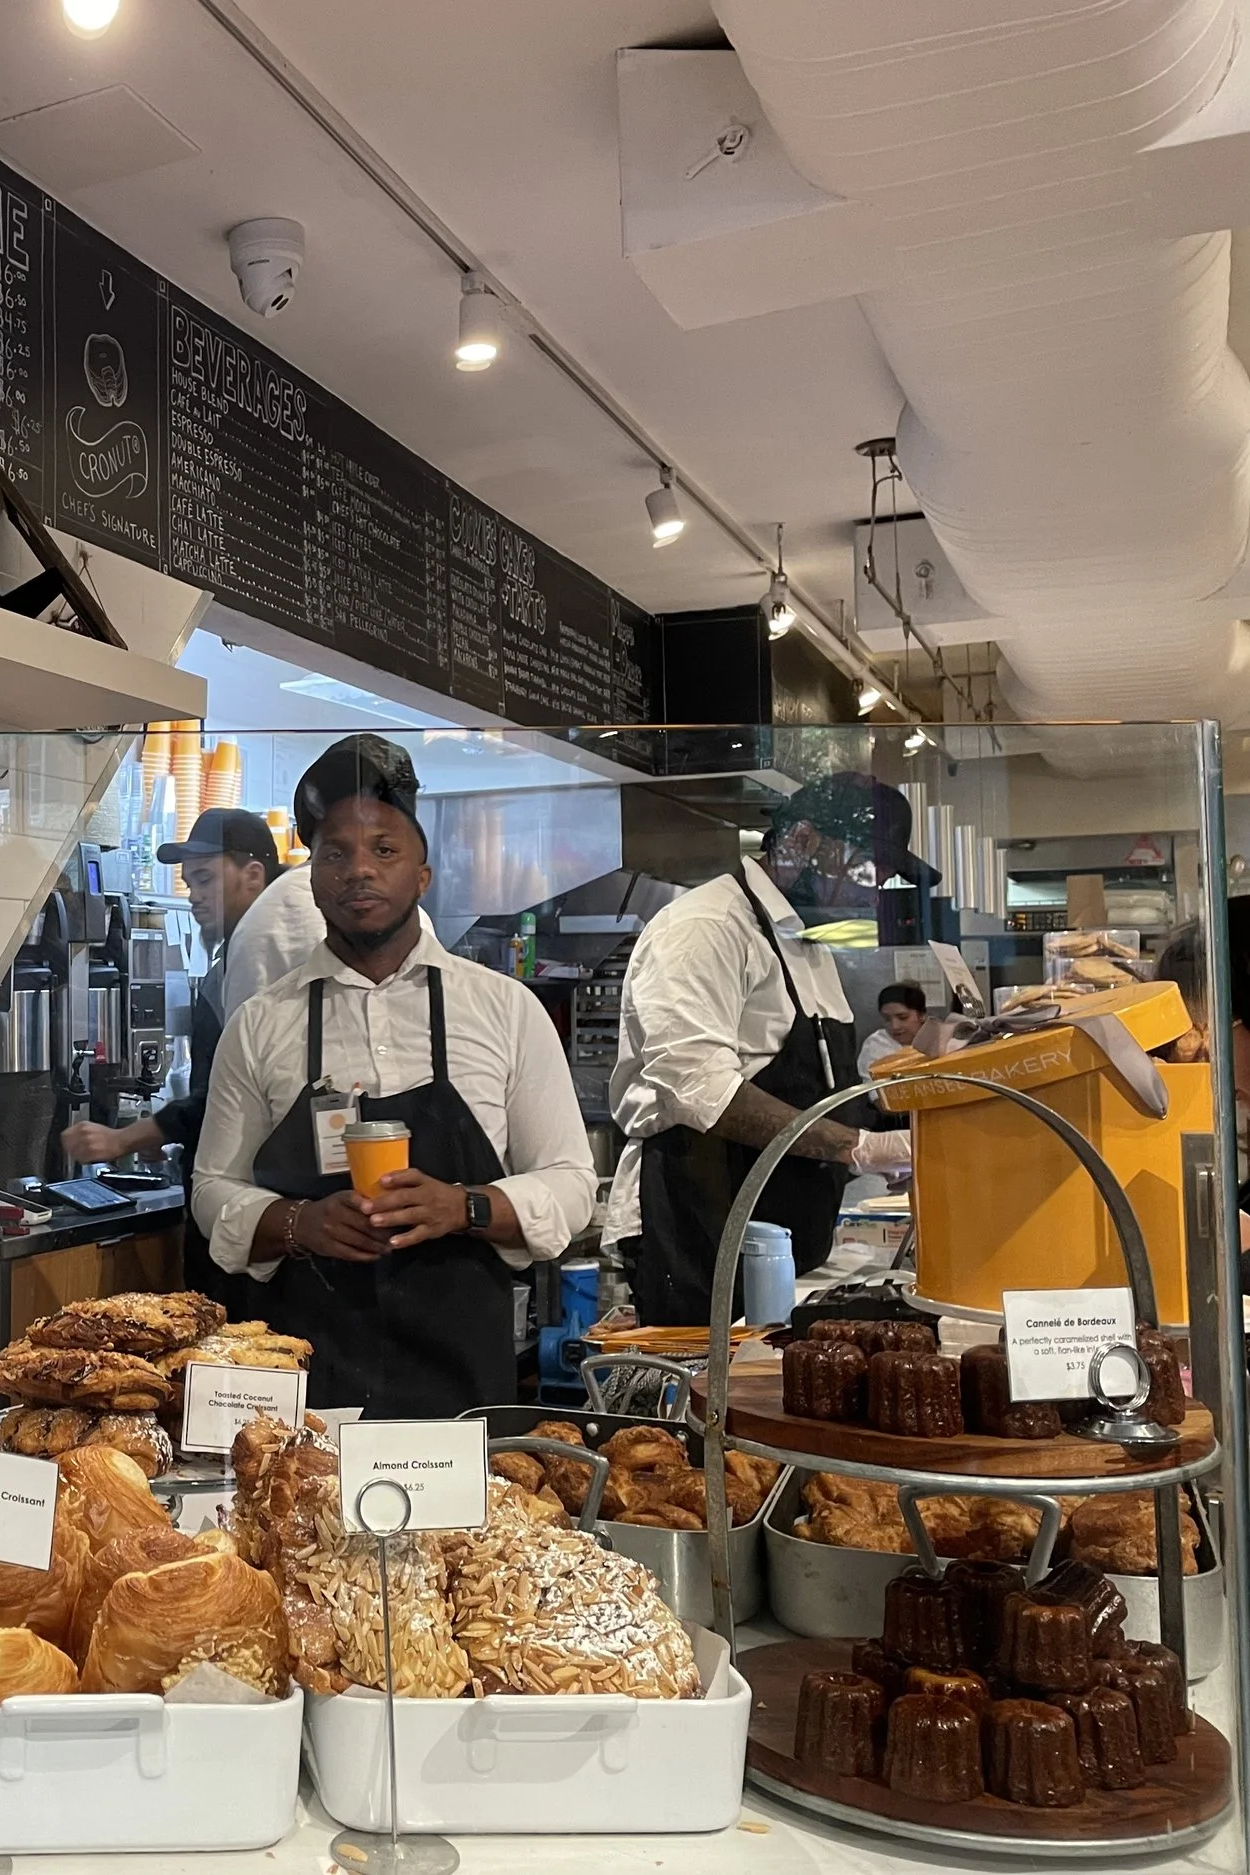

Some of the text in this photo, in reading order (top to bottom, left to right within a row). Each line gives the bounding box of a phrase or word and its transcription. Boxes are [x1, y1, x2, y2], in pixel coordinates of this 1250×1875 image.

[171, 304, 307, 442] BEVERAGES
[171, 366, 229, 415] HOUSE BLEND
[171, 409, 214, 445] ESPRESSO
[203, 405, 222, 430] LAIT
[171, 431, 243, 482] DOUBLE ESPRESSO
[171, 451, 222, 492] AMERICANO
[171, 472, 216, 507] MACCHIATO
[61, 491, 157, 550] CHEF'S SIGNATURE
[171, 514, 226, 552] CHAI LATTE
[196, 503, 225, 532] LATTE
[172, 537, 237, 577] MATCHA LATTE
[172, 553, 223, 585] CAPPUCCINO
[1025, 1316, 1117, 1329] Cannelé de Bordeaux
[1011, 1332, 1133, 1347] A perfectly caramelized shell with
[208, 1399, 245, 1409] Chocolate
[214, 1390, 274, 1402] Toasted Coconut
[372, 1460, 454, 1471] Almond Croissant
[0, 1491, 46, 1509] Croissant
